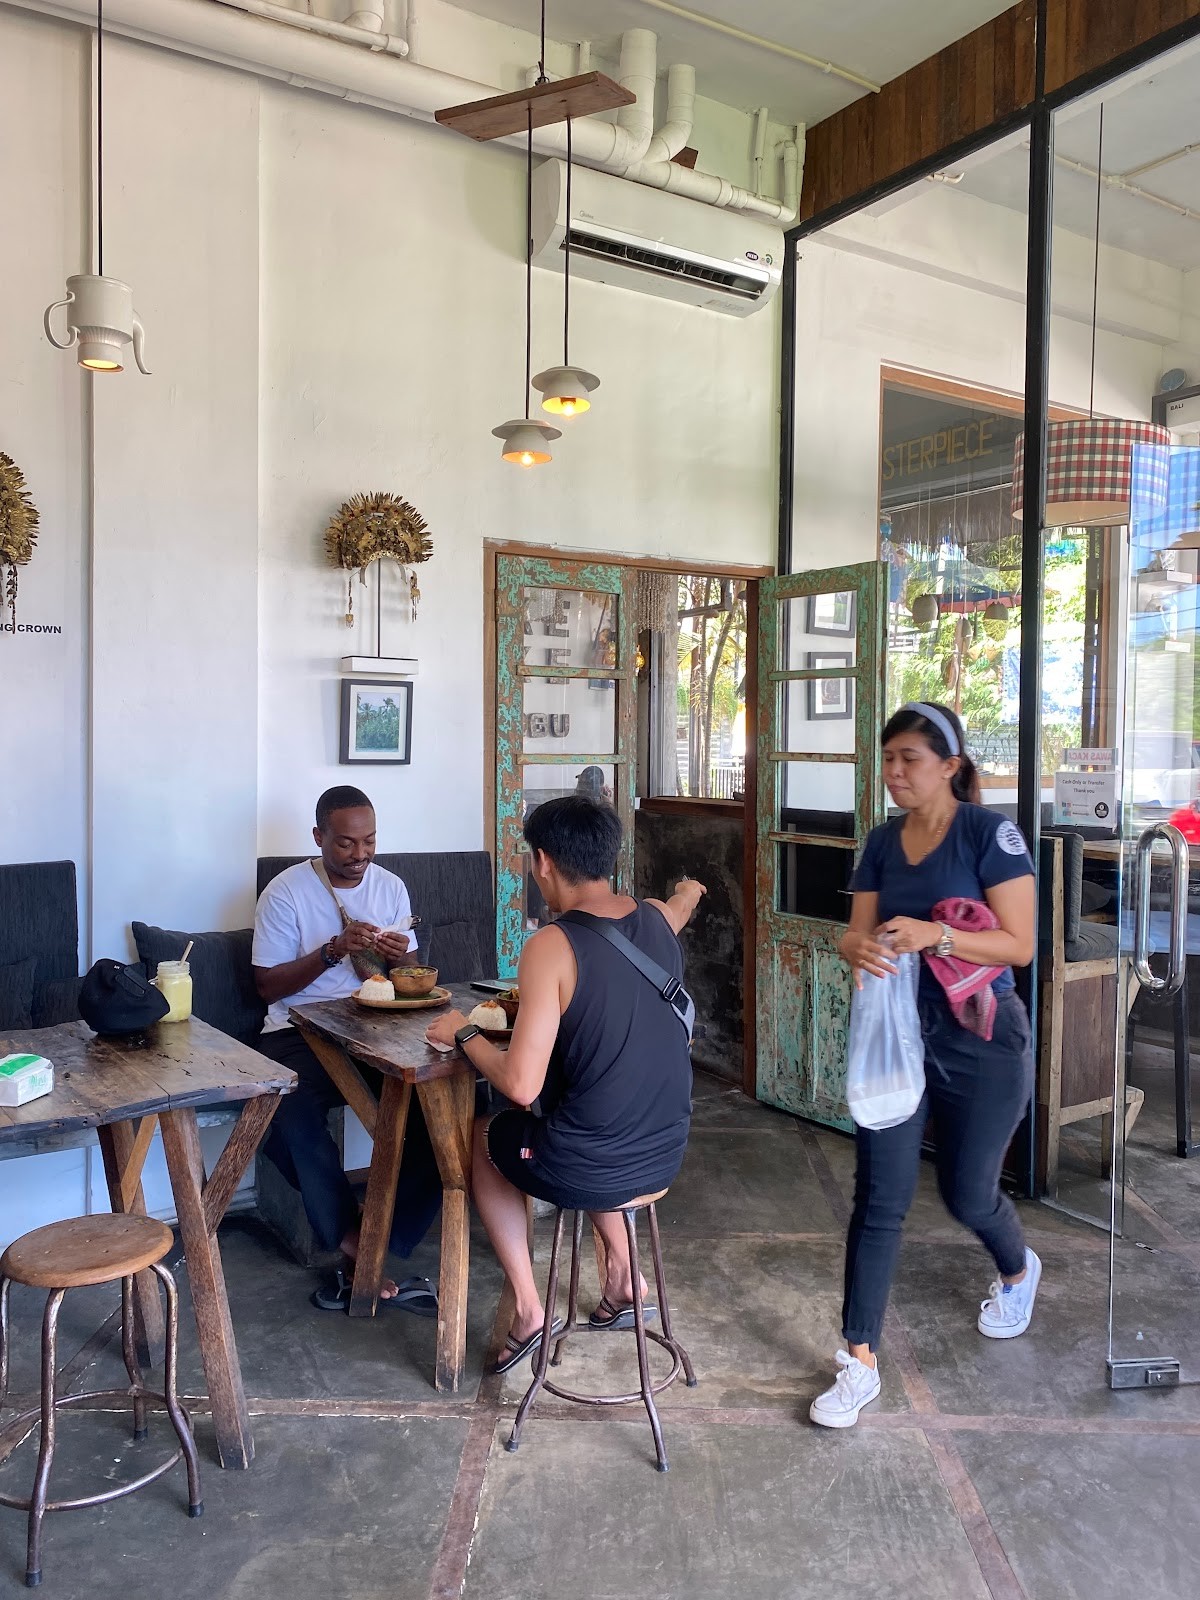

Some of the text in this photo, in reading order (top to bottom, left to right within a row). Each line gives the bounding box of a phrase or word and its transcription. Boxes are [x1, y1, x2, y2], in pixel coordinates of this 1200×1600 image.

[1170, 403, 1184, 411] BALI
[883, 418, 994, 480] STERPIECE
[17, 624, 62, 634] CROWN
[524, 712, 570, 738] GU
